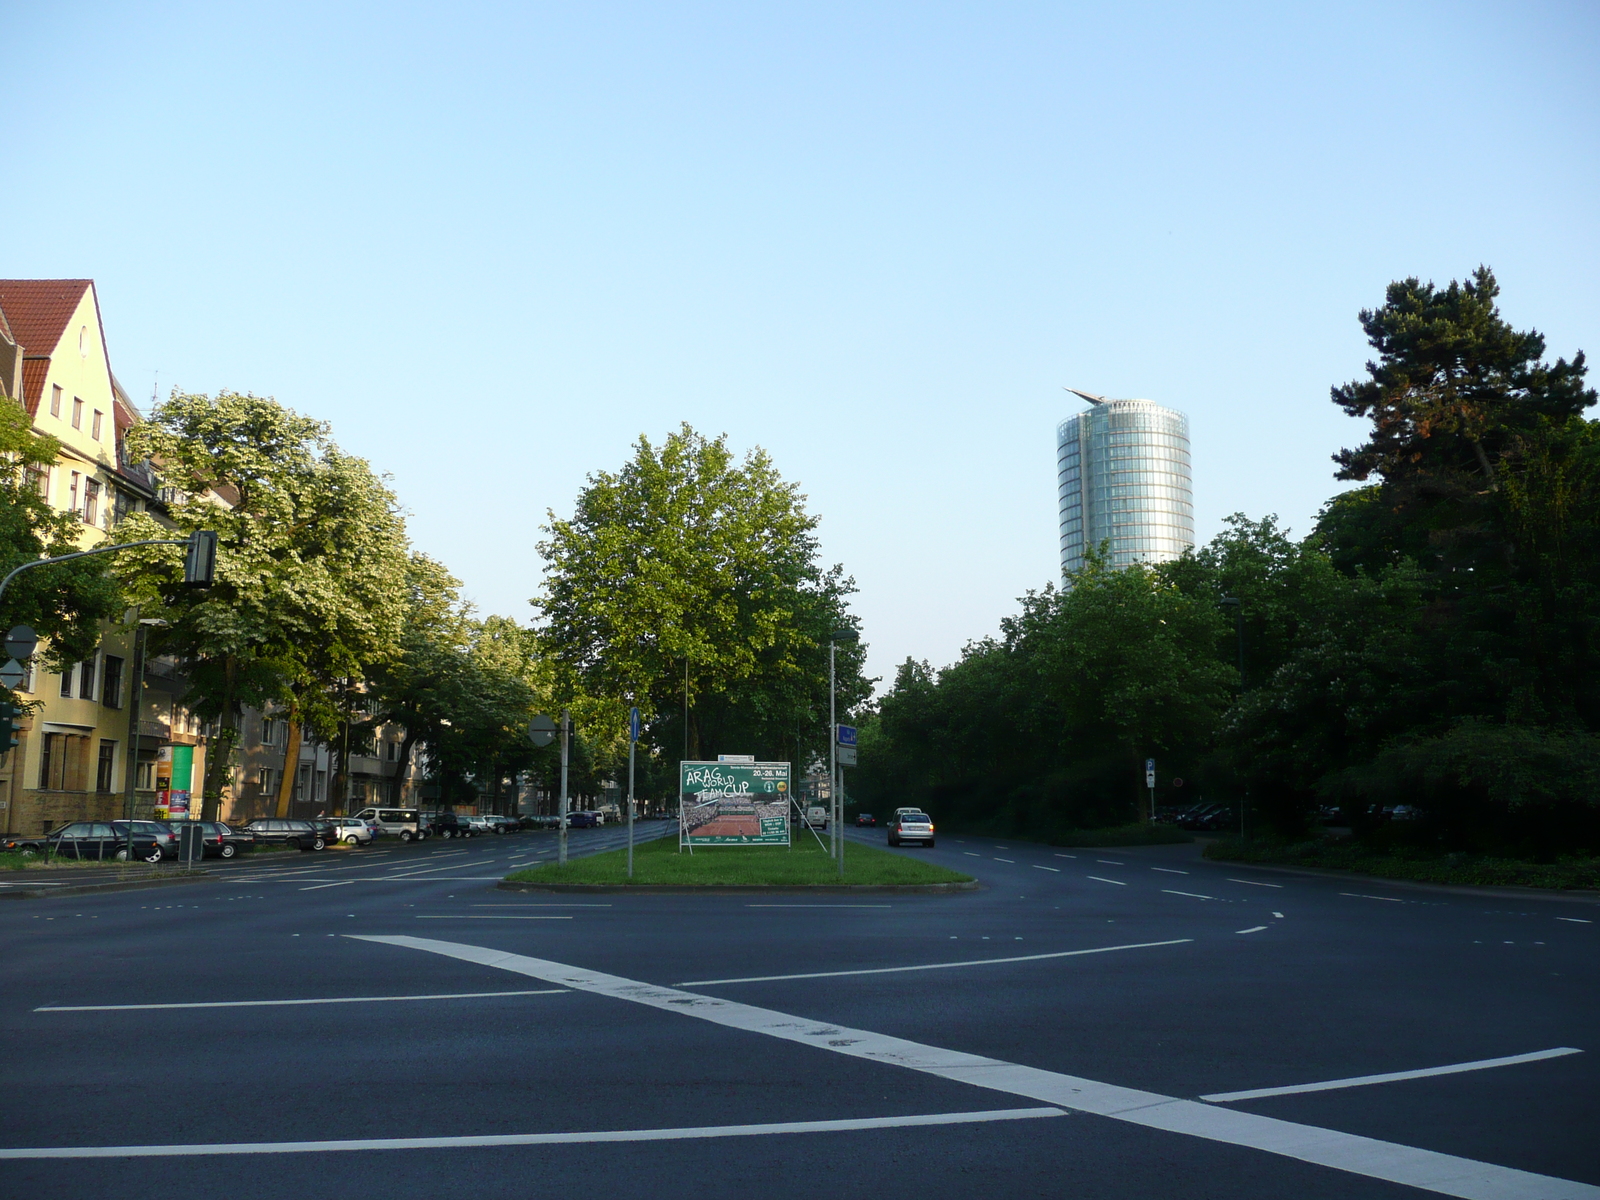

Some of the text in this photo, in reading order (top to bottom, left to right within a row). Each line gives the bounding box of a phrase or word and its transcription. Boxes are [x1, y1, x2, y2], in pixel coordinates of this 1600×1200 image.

[1148, 761, 1153, 770] P
[686, 767, 721, 786] ARAG
[702, 775, 735, 788] WORLD
[694, 781, 749, 802] TEAM CUP
